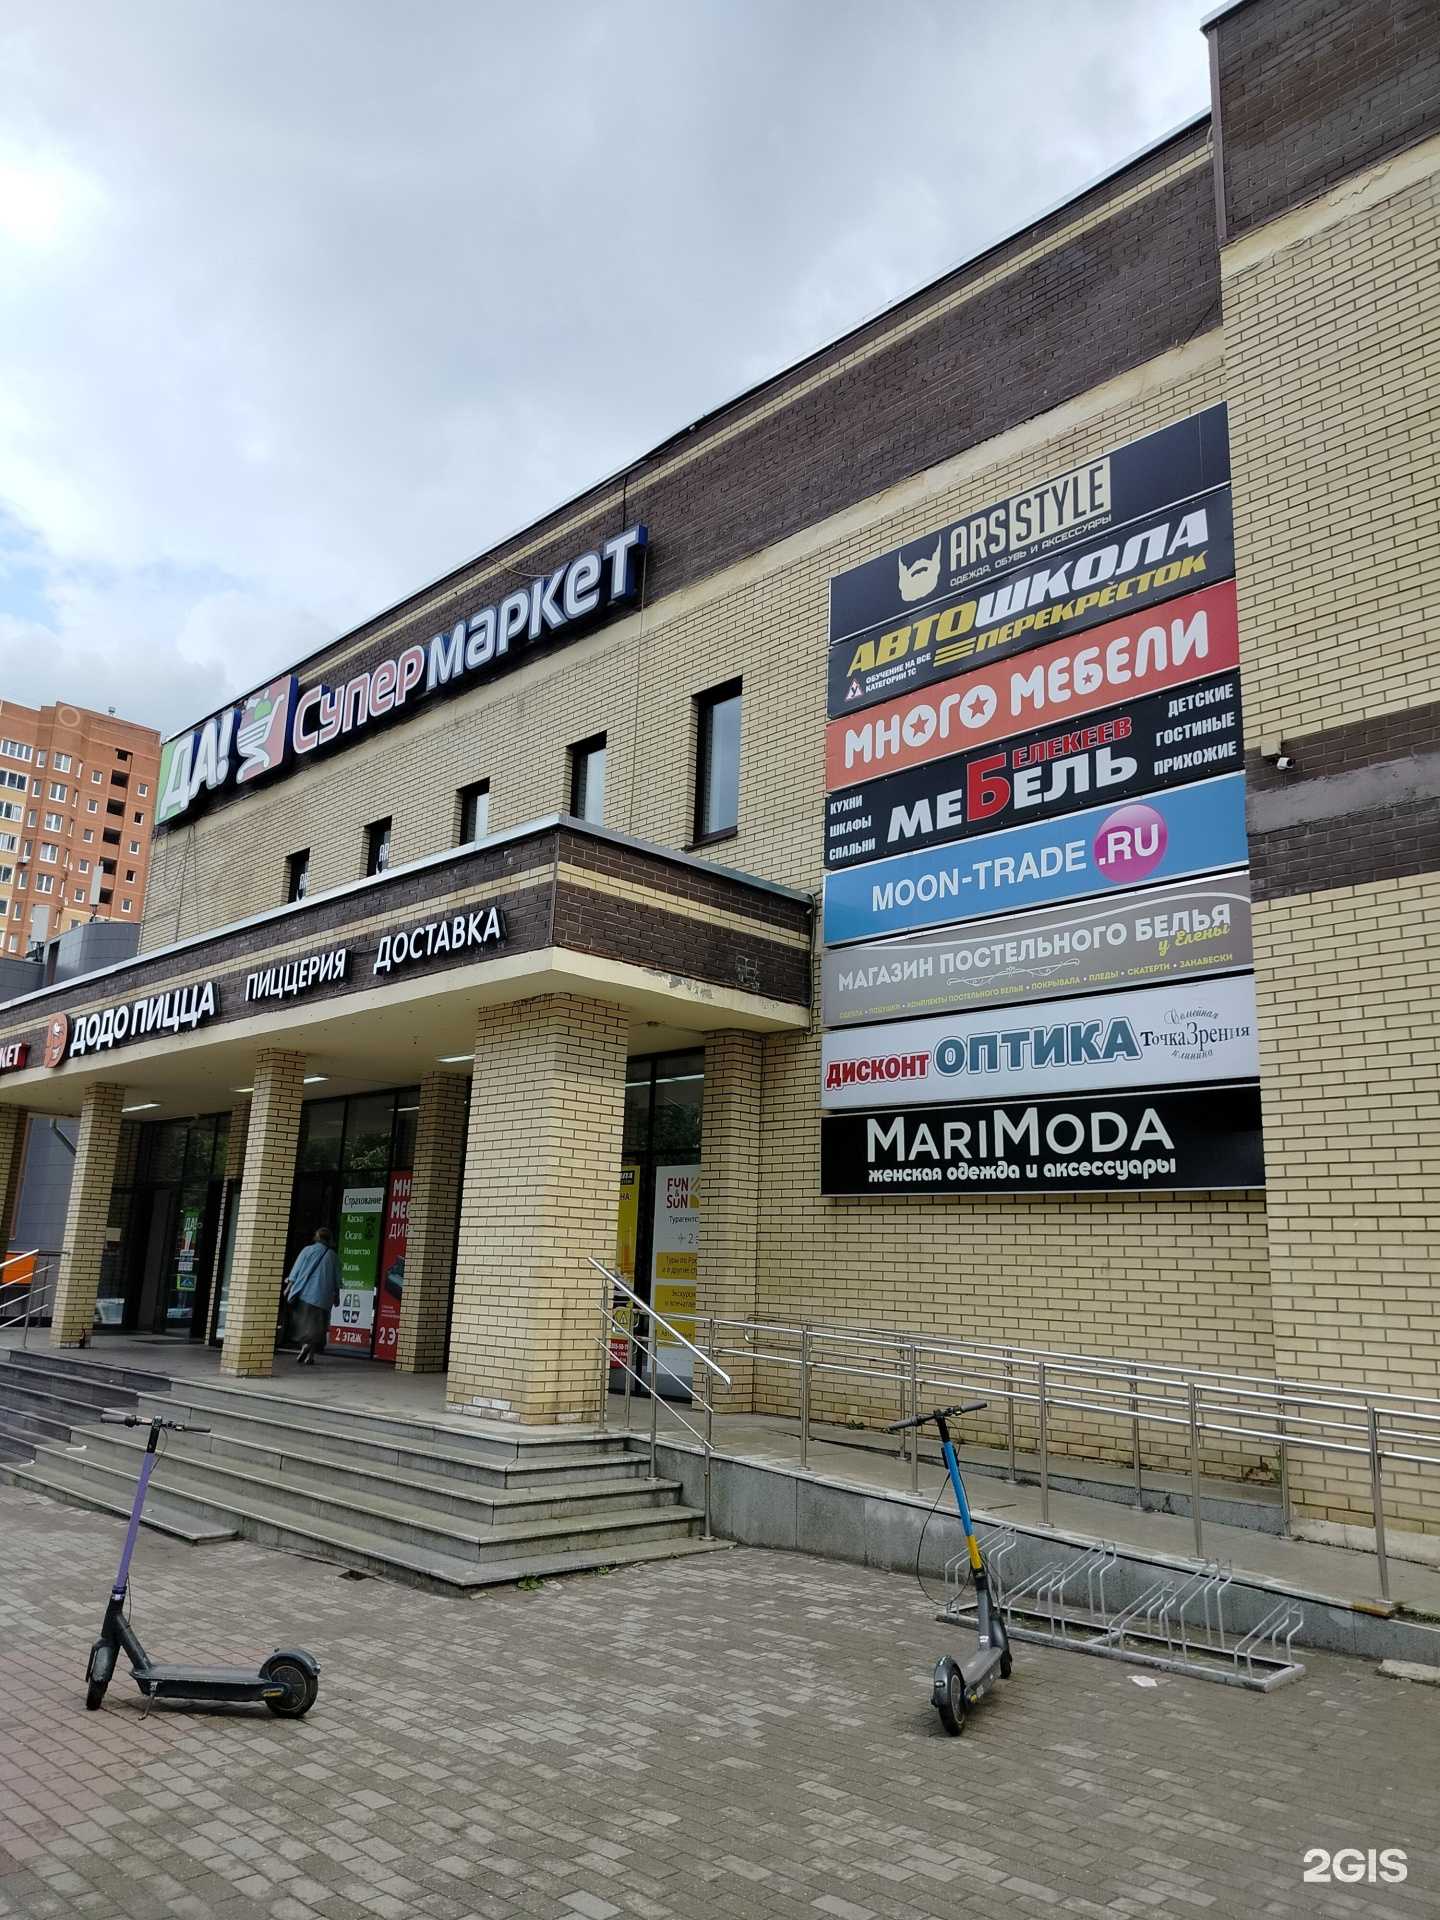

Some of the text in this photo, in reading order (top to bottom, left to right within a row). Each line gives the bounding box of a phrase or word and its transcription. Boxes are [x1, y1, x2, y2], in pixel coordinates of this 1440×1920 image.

[950, 514, 1112, 587] ОДЕЖДА, ОБУВЬ И АКСЕССУАРЫ
[847, 508, 1208, 677] АВТОШКОЛА
[866, 653, 931, 684] ОБУЧЕНИЕ НА ВСЕ
[866, 667, 917, 693] КАТЕГОРИИ ТС
[845, 610, 1208, 768] МНОГО МЕБЕЛИ
[1168, 683, 1233, 718] ДЕТСКИЕ
[1156, 712, 1235, 746] ГОСТИНЫЕ
[159, 709, 234, 821] ДА!
[1154, 741, 1237, 775] ПРИХОЖИЕ
[830, 795, 862, 815] КУХНИ
[830, 816, 872, 837] ШКАФЫ
[829, 838, 875, 860] СПАЛЬНИ
[1098, 824, 1159, 865] .RU
[373, 907, 501, 974] ДОСТАВКА
[838, 903, 1231, 992] МАГАЗИН ПОСТЕЛЬНОГО БЕЛЬЯ
[1175, 924, 1230, 947] Елены
[244, 948, 347, 1001] ПИЦЦЕРИЯ
[948, 988, 1000, 1001] ПОСТЕЛЬНОГО
[1031, 977, 1080, 990] ПОКРЫВАЛА
[1089, 970, 1119, 982] ПЛЕДЫ
[1127, 962, 1170, 976] СКАТЕРТИ
[1180, 953, 1233, 968] ЗАНАВЕСКИ
[69, 982, 215, 1057] ДОДО ПИЦЦА
[826, 1017, 1142, 1090] ДИСКОНТ ОПТИКА
[667, 1177, 689, 1194] FUN
[868, 1158, 1176, 1183] женская одежда и аксессуары
[666, 1194, 688, 1208] SUN
[335, 1328, 362, 1344] 2 этаж
[378, 1326, 385, 1344] 2
